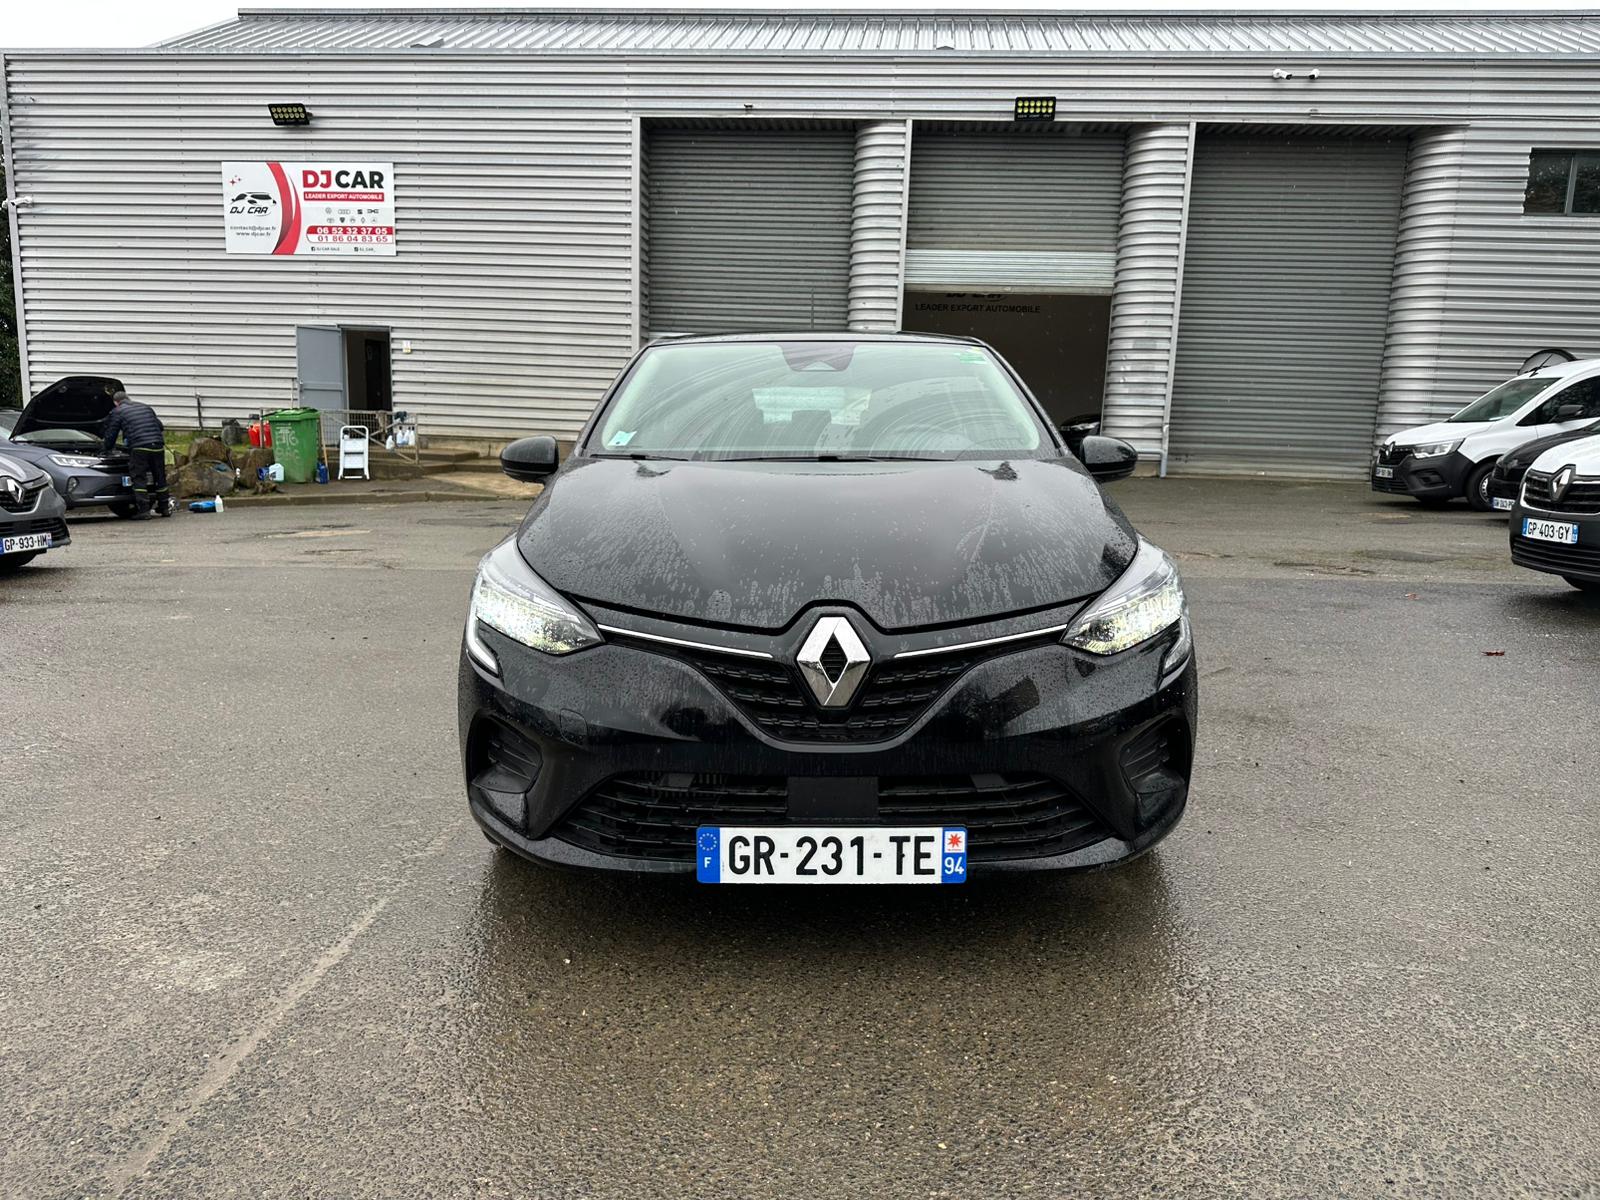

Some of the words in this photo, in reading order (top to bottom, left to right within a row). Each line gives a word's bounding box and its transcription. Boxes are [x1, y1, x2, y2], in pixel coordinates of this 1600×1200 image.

[302, 170, 332, 189] DJ
[335, 170, 384, 189] CAR
[229, 206, 245, 214] DJ
[247, 206, 268, 214] CAR
[361, 227, 373, 235] 37
[375, 227, 387, 235] 05
[915, 303, 948, 311] LEADER
[950, 304, 984, 312] EXPORT
[985, 304, 1041, 313] AUTOMOBILE
[1527, 521, 1570, 540] GP-403-GY
[704, 857, 711, 868] F
[728, 835, 936, 876] GR-231-TE
[944, 856, 965, 875] 94
